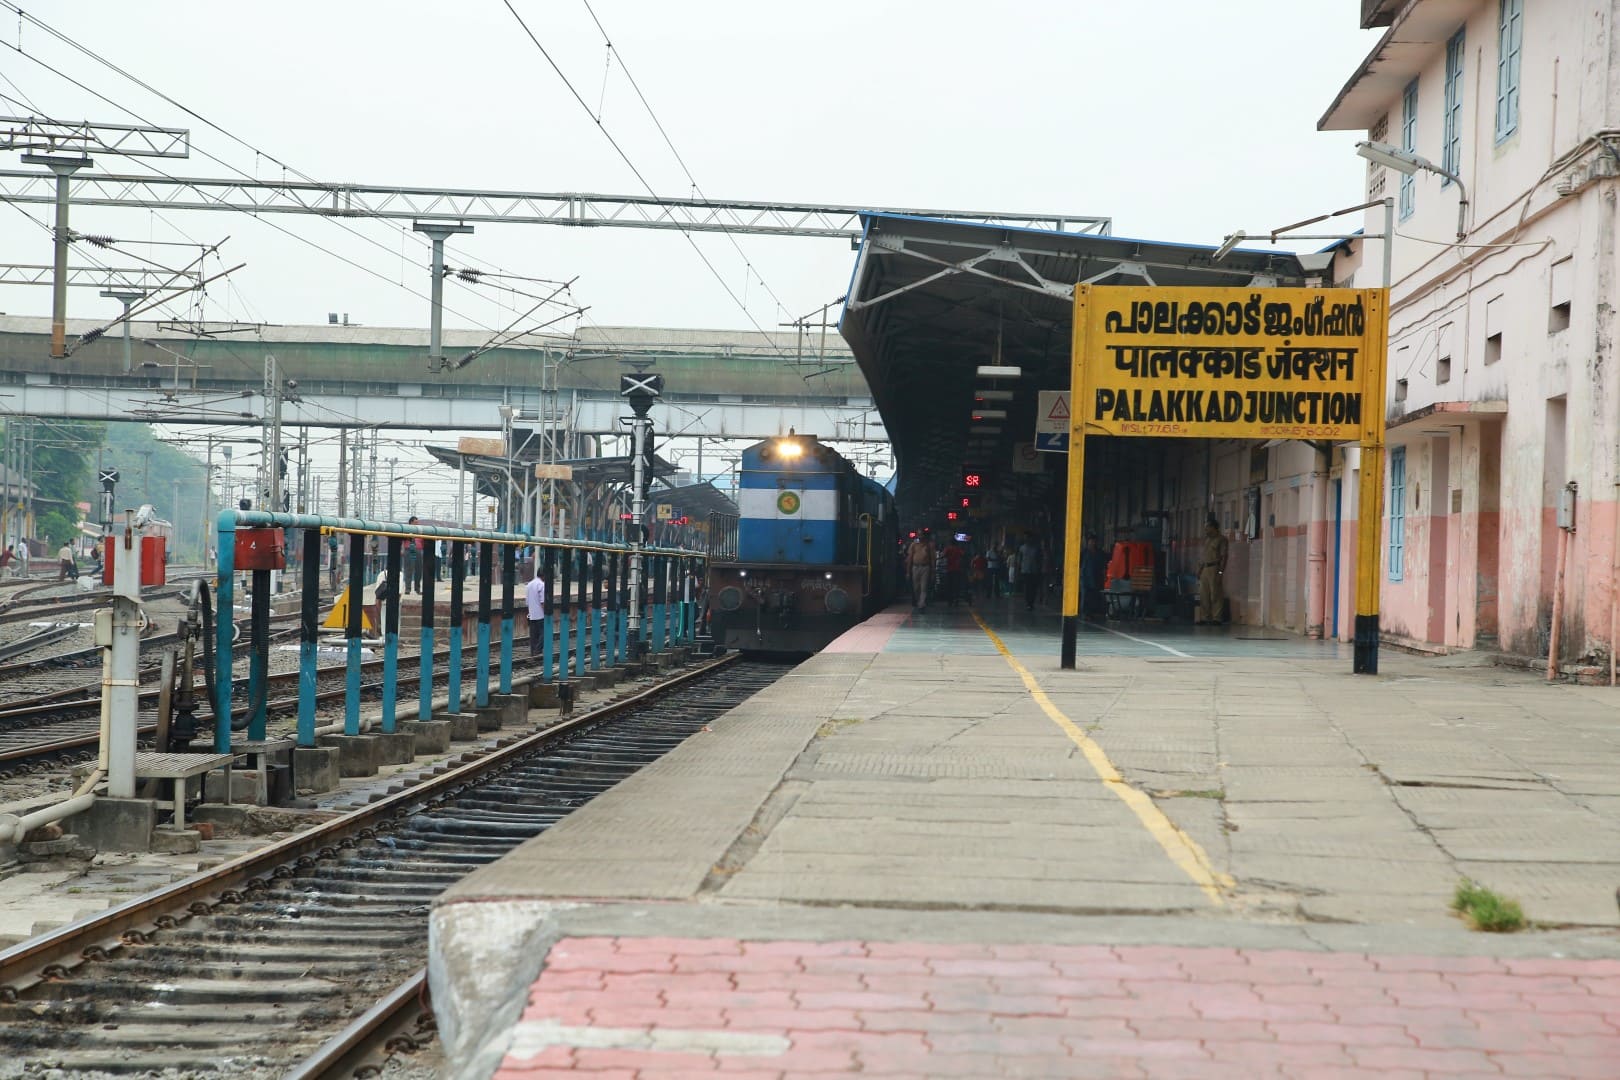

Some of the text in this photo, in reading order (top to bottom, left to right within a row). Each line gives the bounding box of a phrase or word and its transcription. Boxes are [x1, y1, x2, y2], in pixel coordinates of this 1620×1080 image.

[1106, 294, 1262, 336] പാലക്കാട്
[1106, 339, 1359, 381] पालक्काड जंक्शन
[1095, 388, 1361, 425] PALAKKAD JUNCTION
